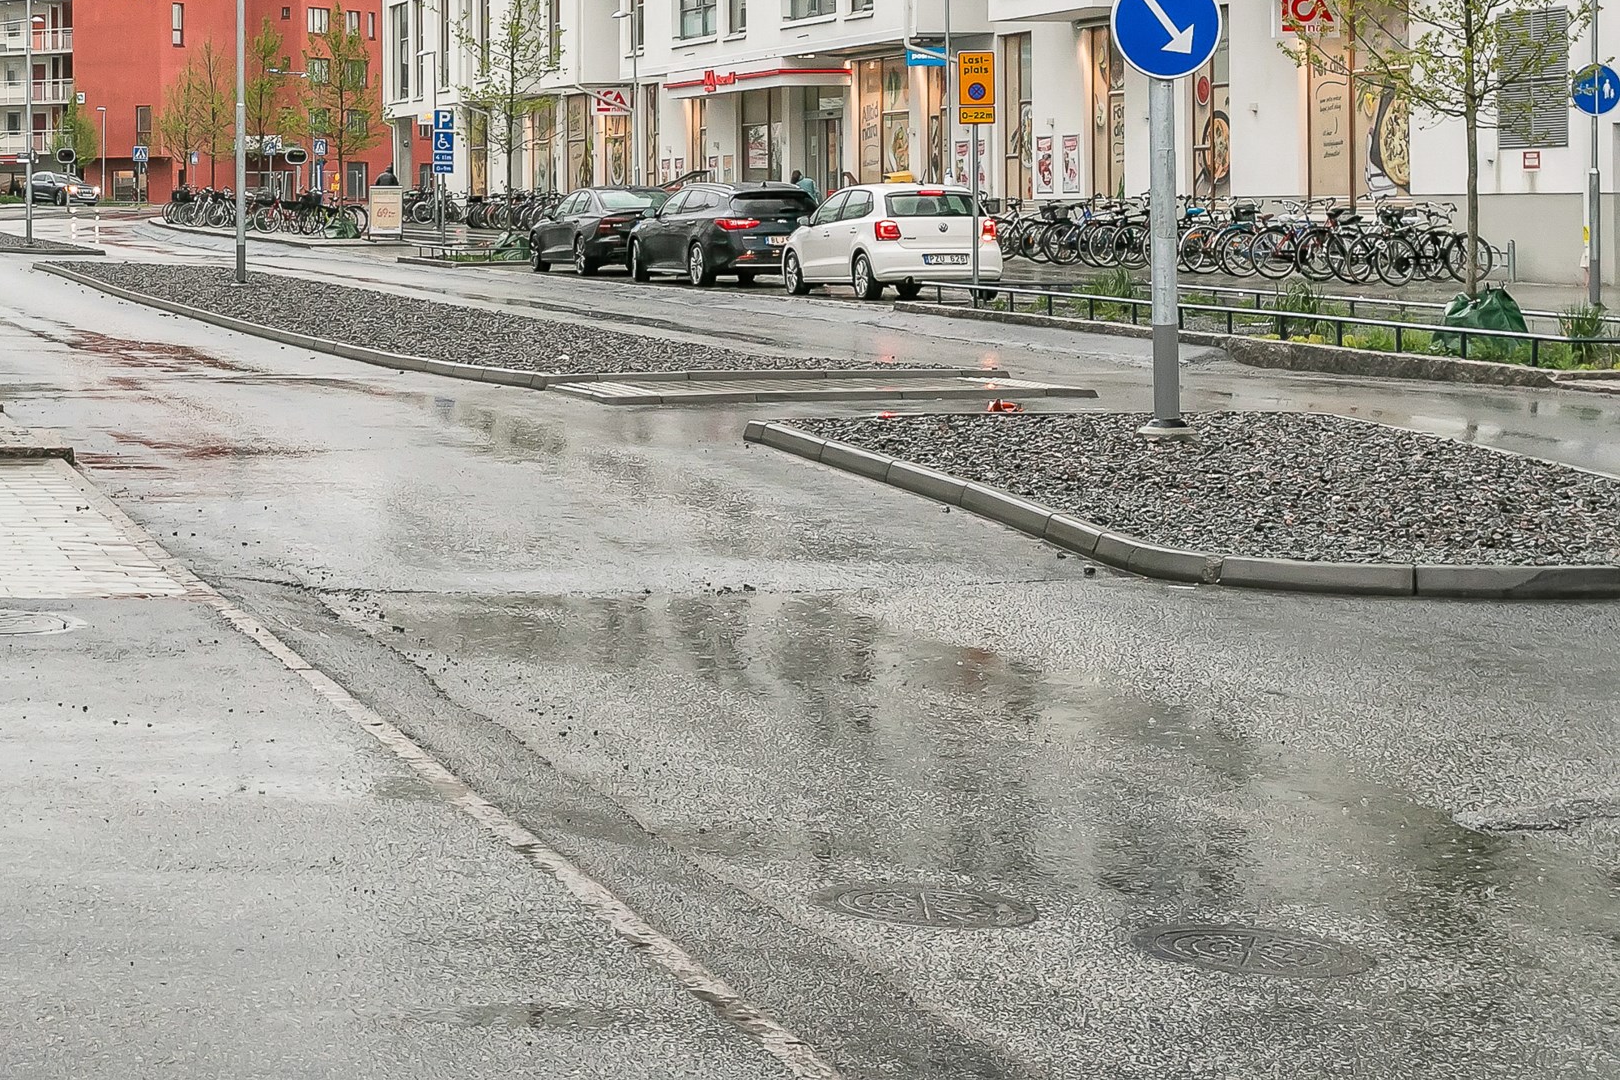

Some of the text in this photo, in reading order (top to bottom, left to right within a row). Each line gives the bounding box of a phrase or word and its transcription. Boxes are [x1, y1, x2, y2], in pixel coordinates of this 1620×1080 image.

[963, 56, 990, 64] Last-
[963, 66, 989, 75] plats
[597, 90, 628, 107] ICA
[439, 111, 451, 129] P
